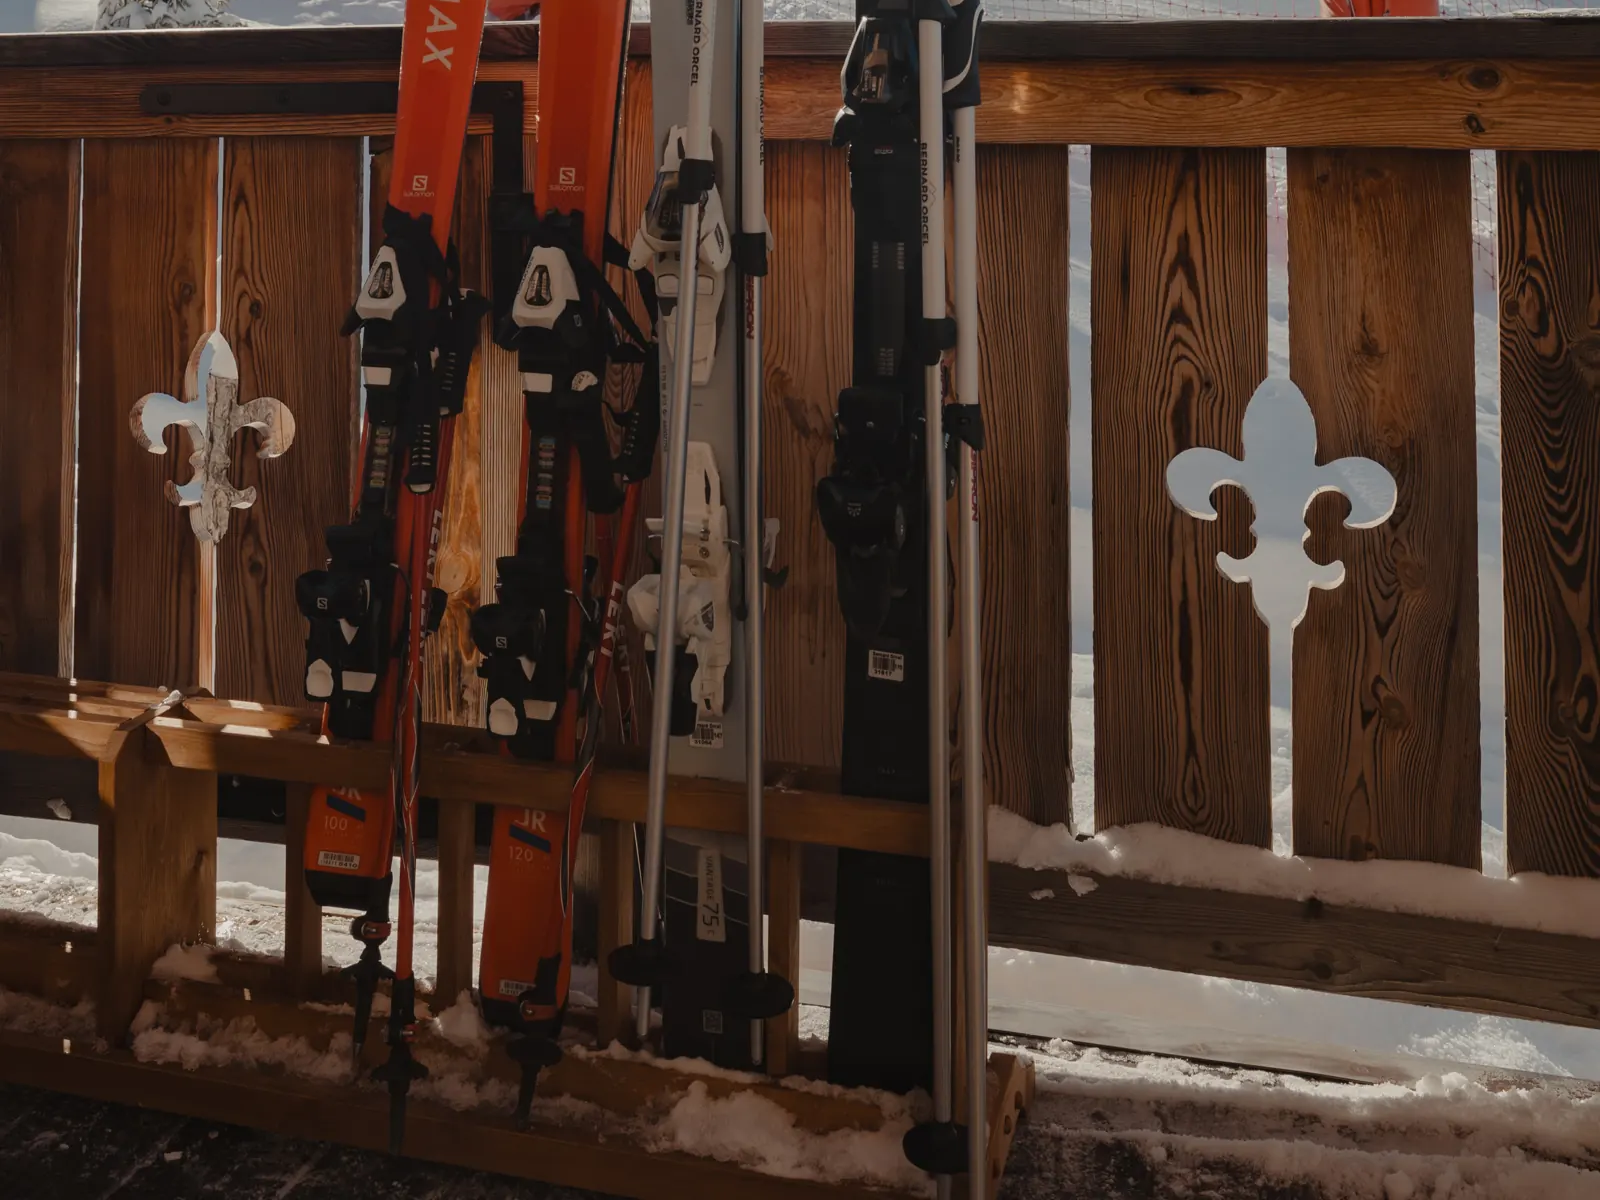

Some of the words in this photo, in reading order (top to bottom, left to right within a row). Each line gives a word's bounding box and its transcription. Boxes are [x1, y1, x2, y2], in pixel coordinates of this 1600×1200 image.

[691, 47, 700, 86] ORCEL
[600, 579, 624, 658] LEKI
[324, 815, 348, 831] 100
[514, 808, 547, 834] JR
[509, 845, 534, 863] 120
[702, 902, 720, 927] 75
